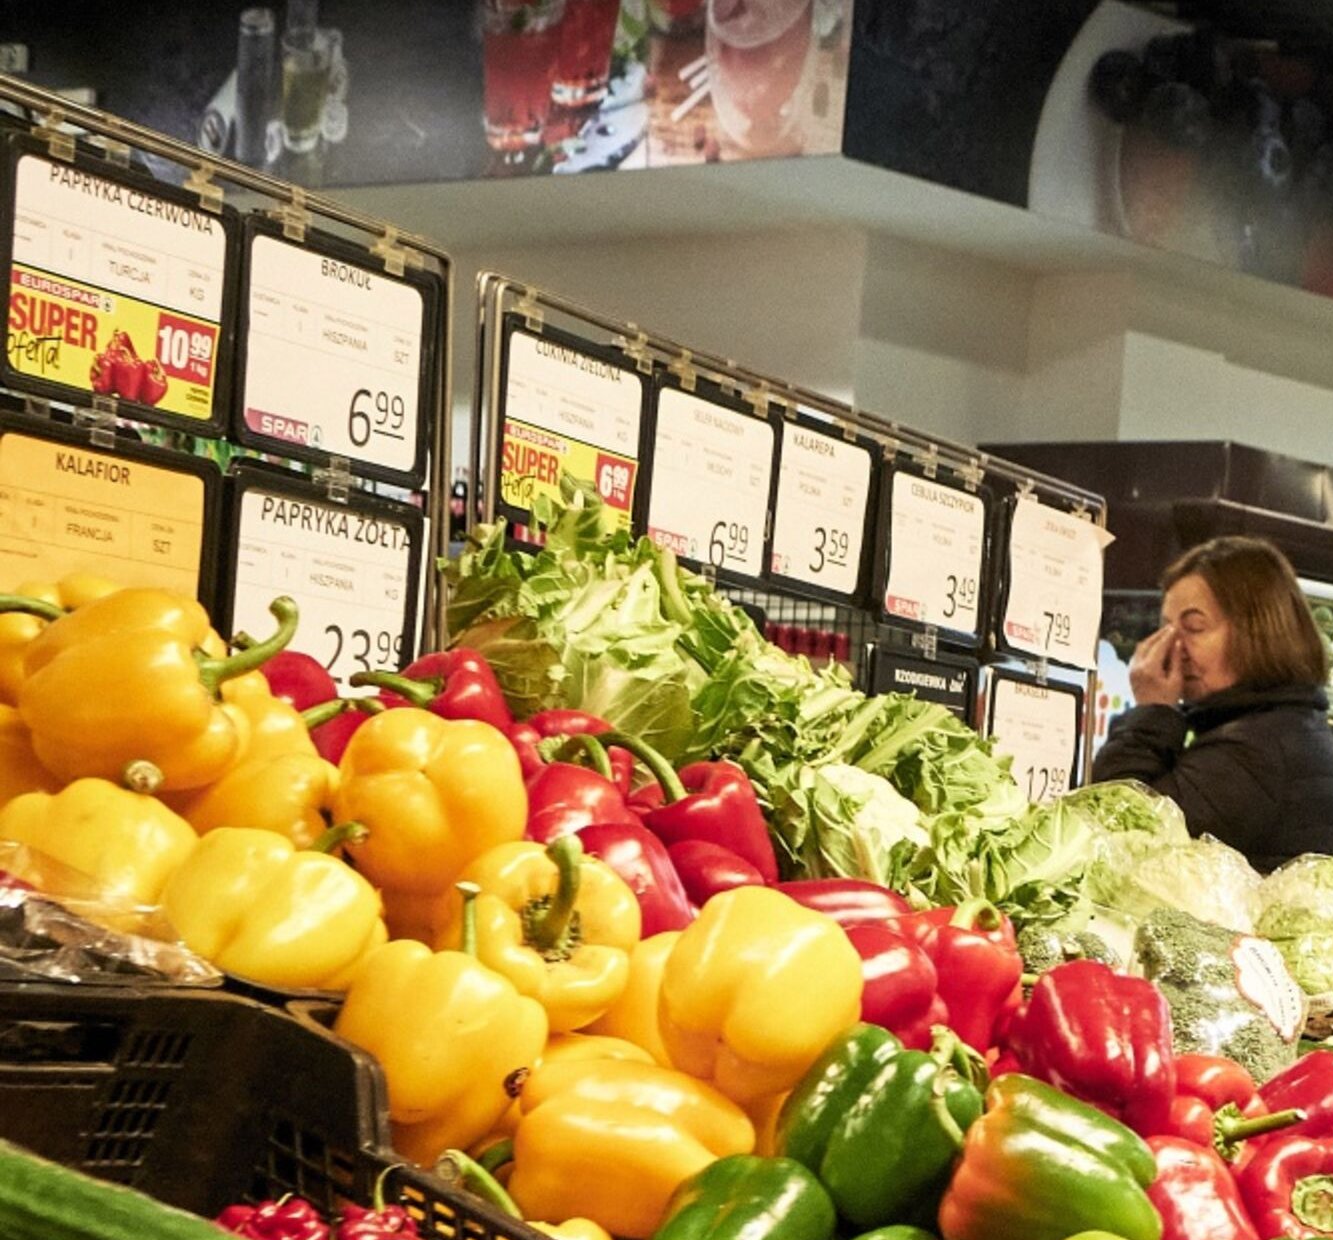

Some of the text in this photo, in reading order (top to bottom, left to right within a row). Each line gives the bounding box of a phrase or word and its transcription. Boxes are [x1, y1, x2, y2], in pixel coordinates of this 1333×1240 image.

[51, 166, 213, 235] PAPRYKA CZERWONA
[108, 260, 151, 284] TURCJA
[20, 273, 101, 308] EUROSPAR
[9, 292, 98, 351] SUPER
[261, 415, 308, 441] SPAR
[56, 452, 131, 486] KALAFIOR
[503, 441, 559, 486] SUPER
[66, 522, 114, 543] FRANCJA
[261, 496, 349, 540] PAPRYKA
